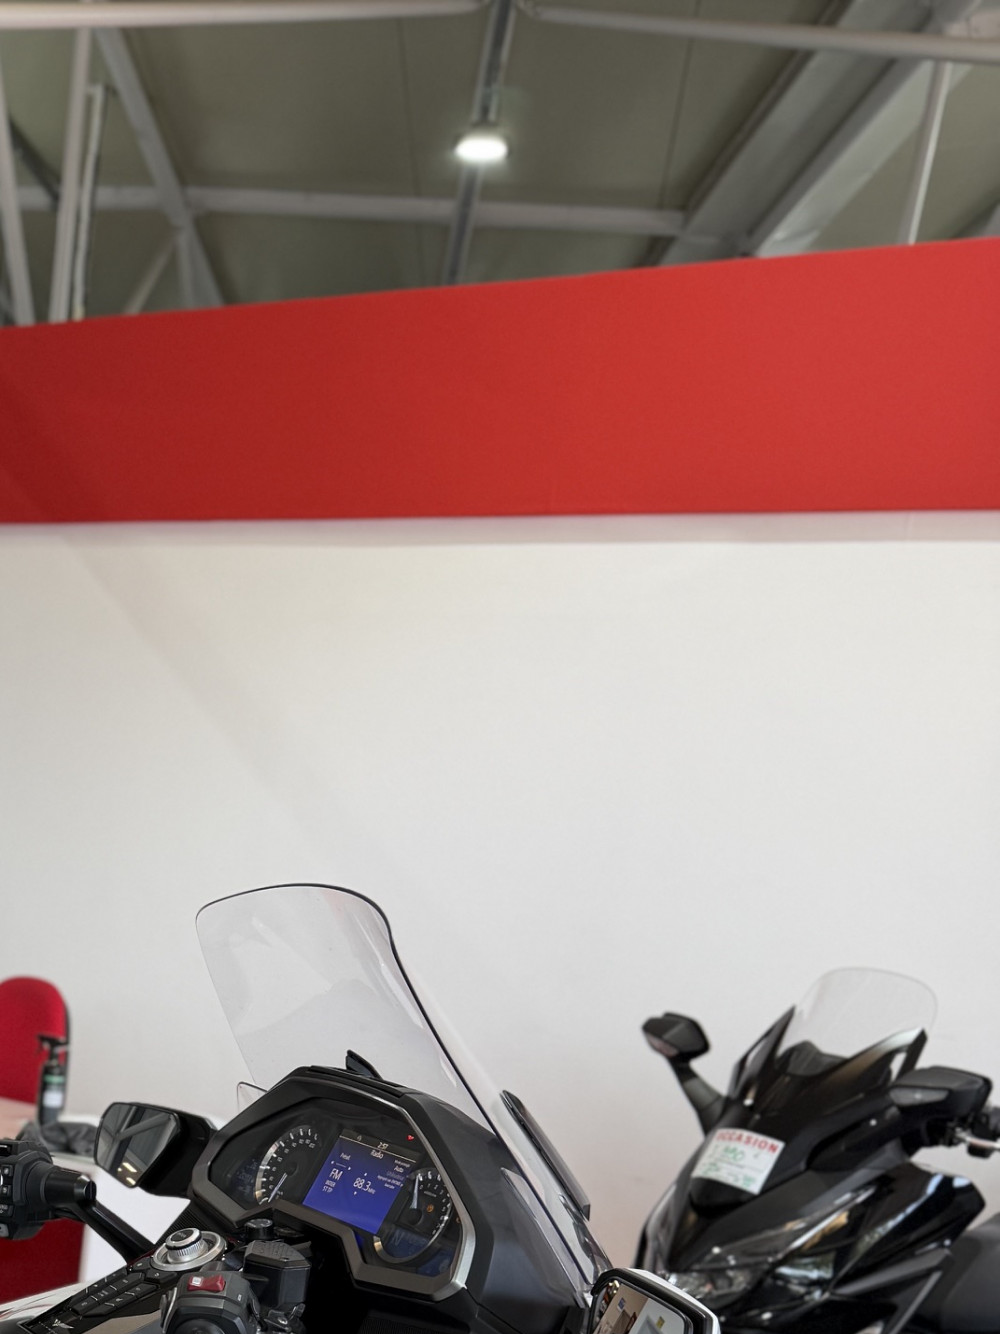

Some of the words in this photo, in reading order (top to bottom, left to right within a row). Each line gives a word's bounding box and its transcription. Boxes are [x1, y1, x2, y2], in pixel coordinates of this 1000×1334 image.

[370, 1150, 384, 1159] Radio
[329, 1168, 343, 1181] FM
[353, 1177, 372, 1191] 88.3
